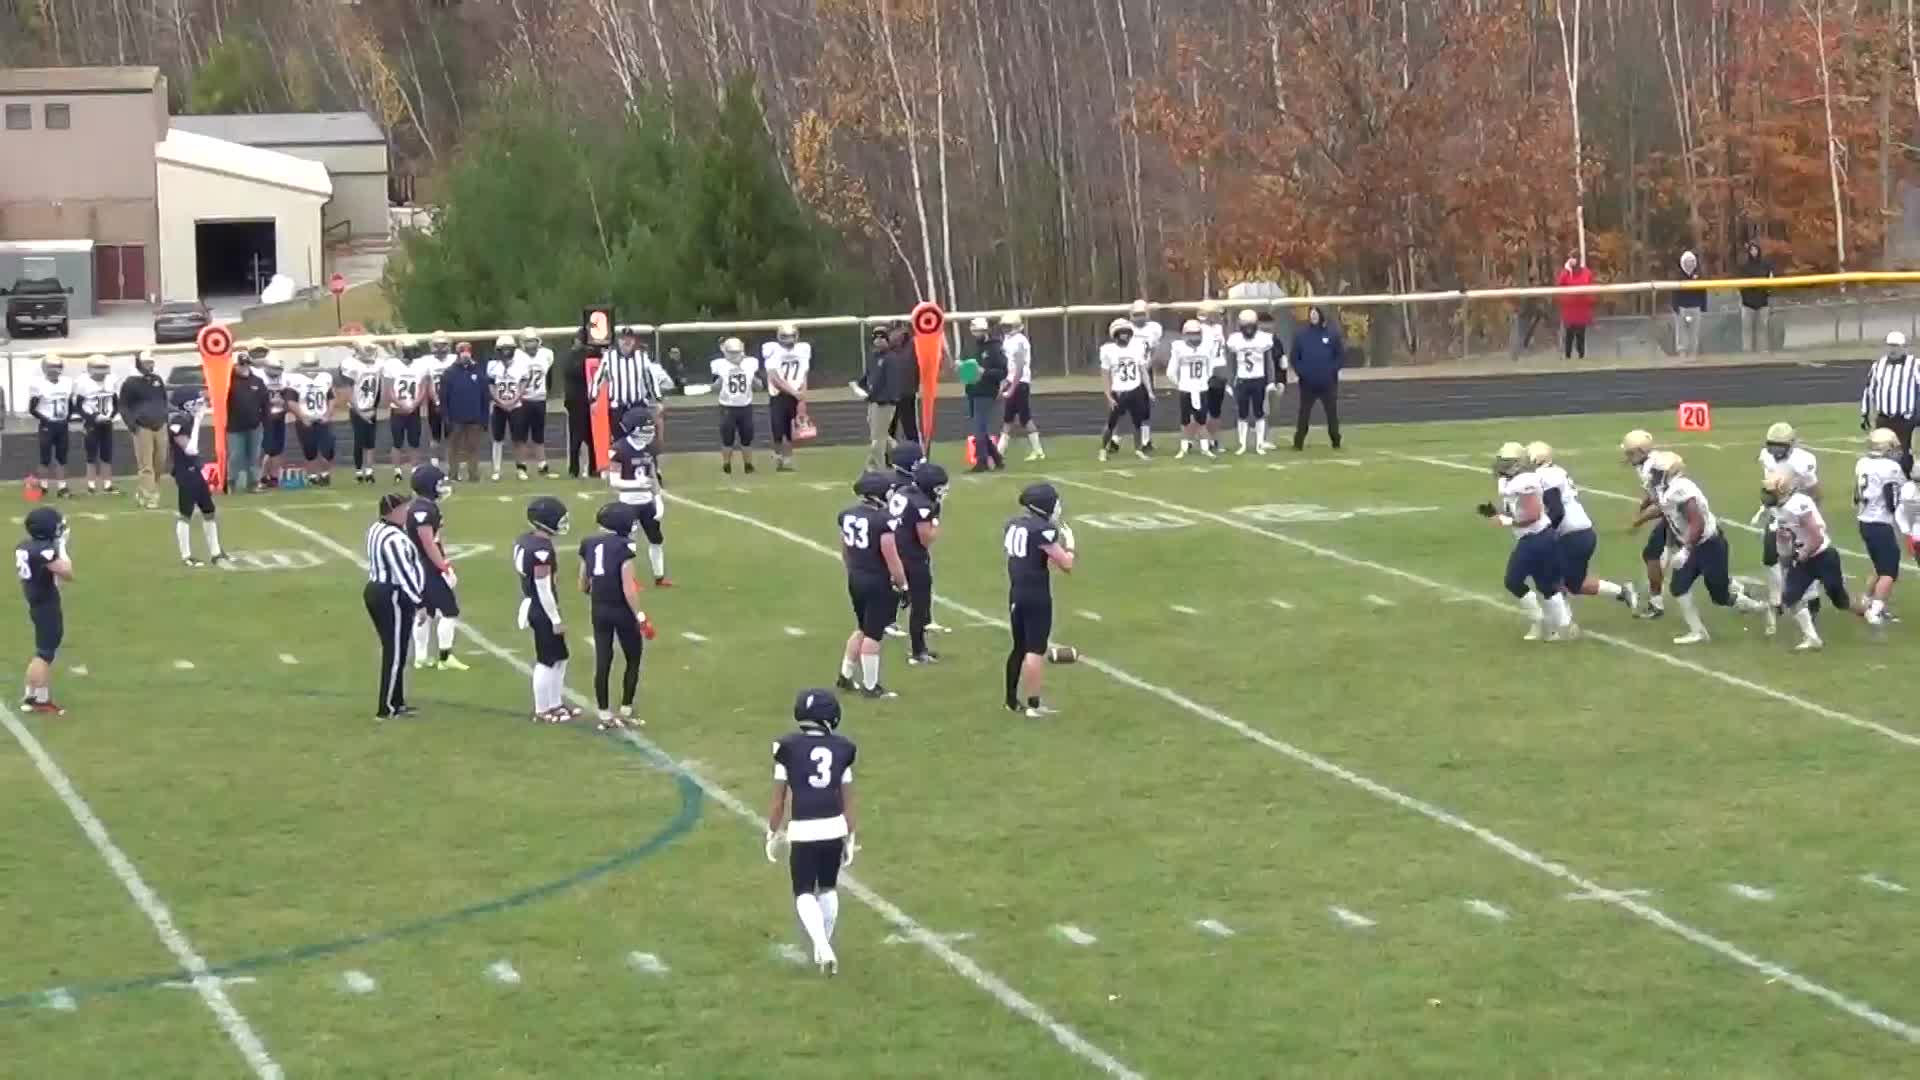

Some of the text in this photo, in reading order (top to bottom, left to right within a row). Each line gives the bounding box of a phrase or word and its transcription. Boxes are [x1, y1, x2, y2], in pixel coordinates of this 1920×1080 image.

[781, 360, 800, 381] 77
[1119, 361, 1133, 382] 33
[1244, 351, 1254, 372] 5
[398, 379, 416, 400] 24
[498, 381, 516, 401] 25
[729, 374, 746, 393] 68
[305, 391, 325, 410] 60
[1683, 406, 1705, 427] 20
[843, 514, 869, 549] 53
[1004, 524, 1027, 558] 40
[593, 543, 604, 575] 1
[808, 746, 833, 789] 3
